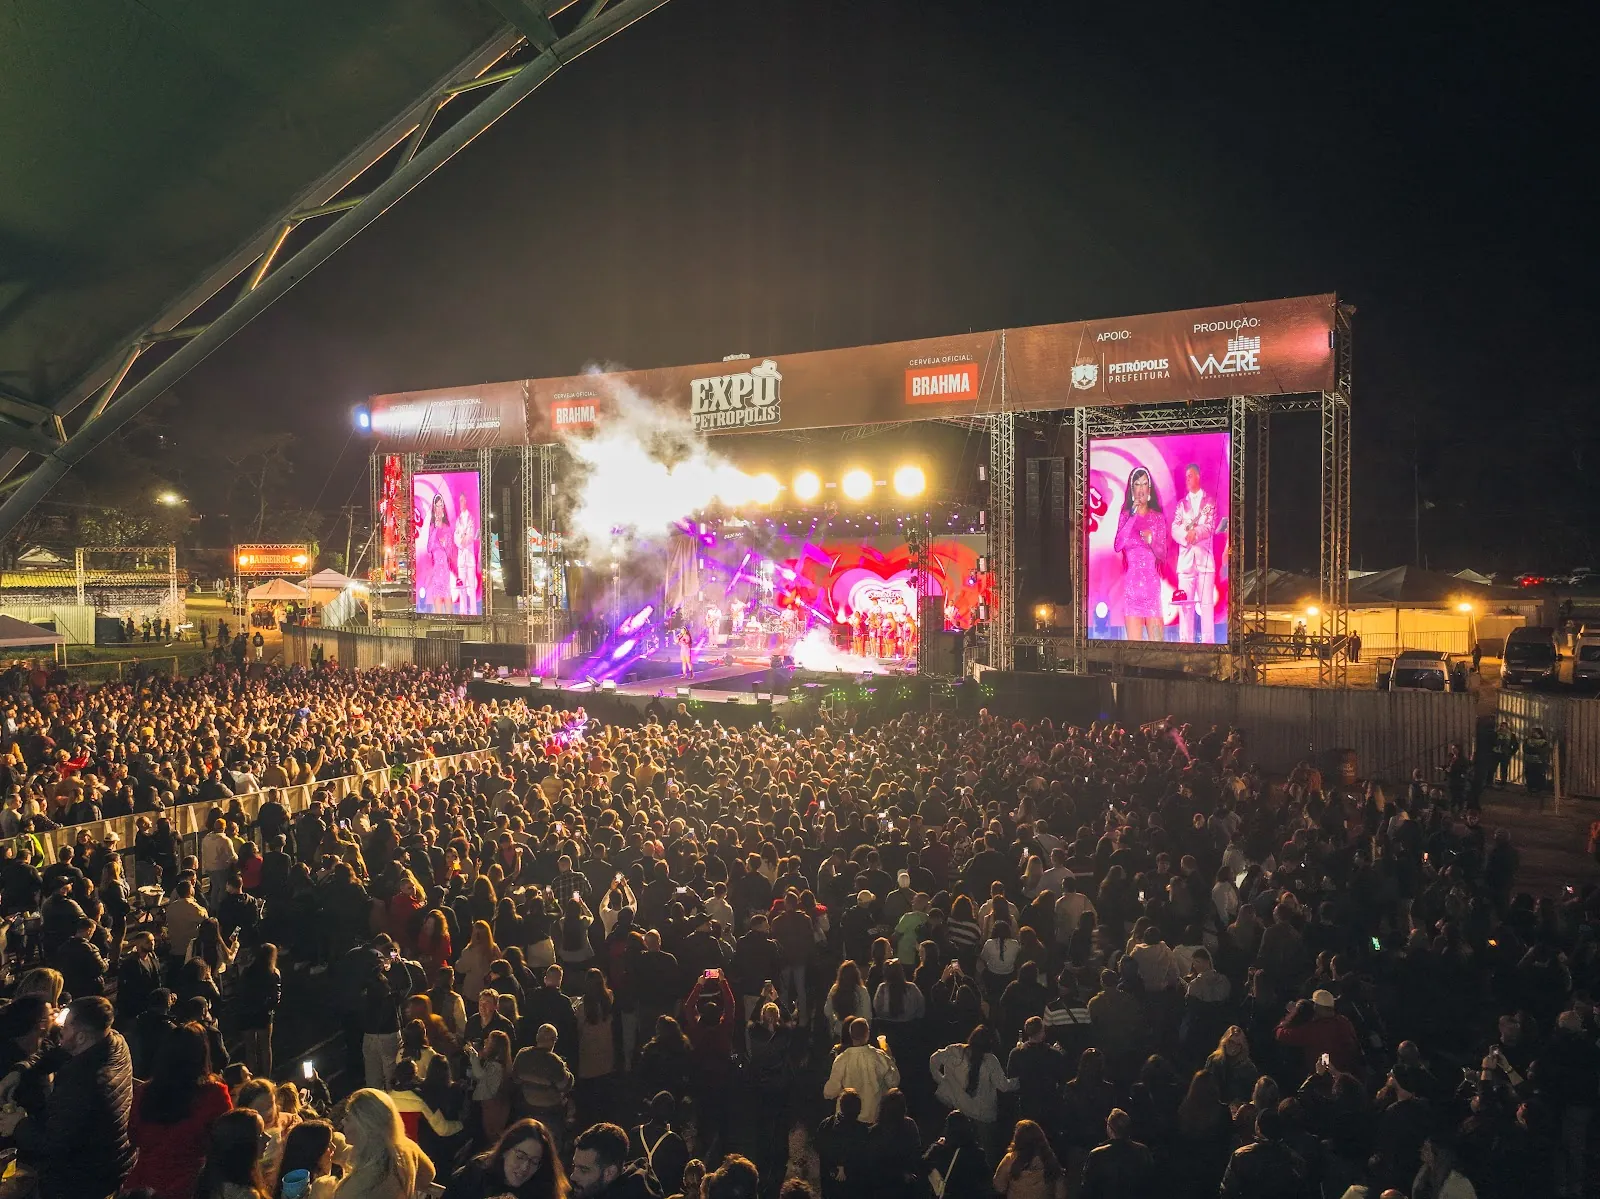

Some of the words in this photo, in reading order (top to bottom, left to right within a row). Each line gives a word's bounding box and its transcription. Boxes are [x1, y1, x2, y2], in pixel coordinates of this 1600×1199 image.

[1193, 317, 1261, 333] PRODUÇÃO:
[1096, 330, 1132, 342] APOIO:
[909, 358, 940, 366] CERVEJA
[941, 354, 973, 363] OFICIAL:
[1108, 359, 1169, 374] PETRÓPOLIS
[912, 372, 970, 397] BRAHMA
[1108, 370, 1171, 384] PREFEITURA
[690, 372, 777, 414] EXPO
[556, 405, 596, 424] BRAHMA
[692, 404, 776, 430] PETRÓPOLIS
[467, 422, 475, 430] DE
[475, 421, 501, 429] JANEIRO
[249, 555, 291, 564] BANHEIROS
